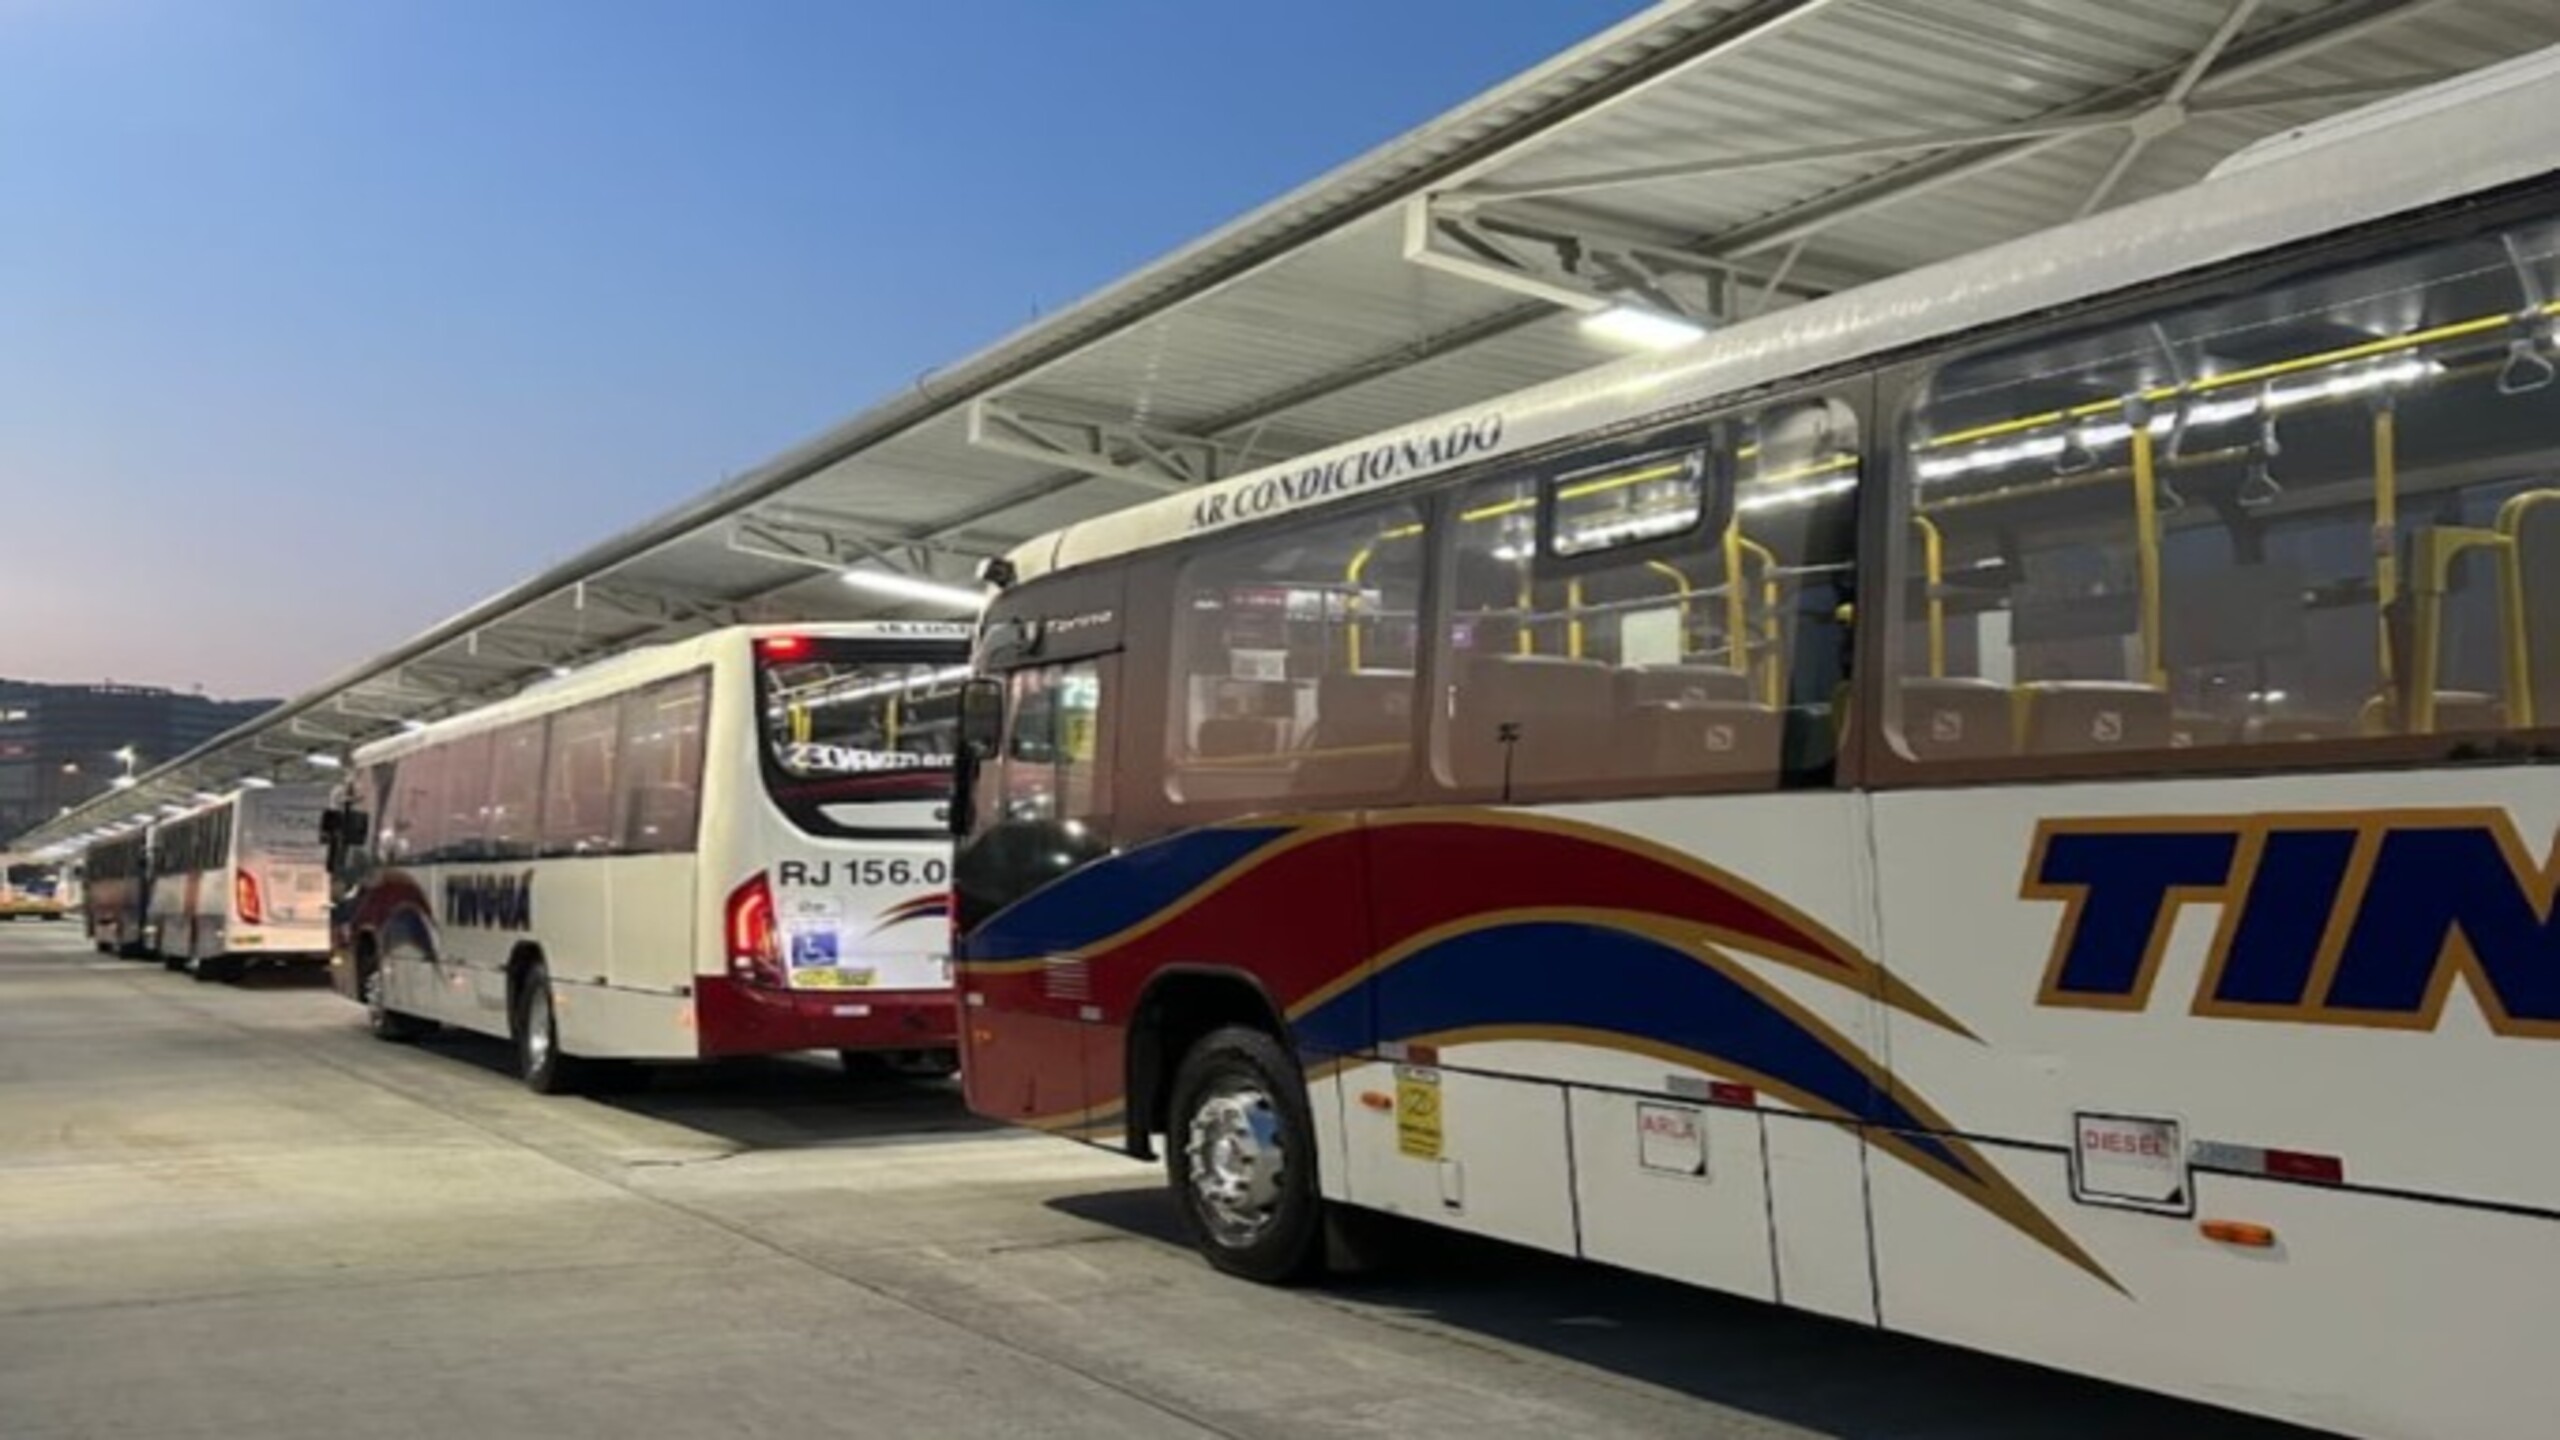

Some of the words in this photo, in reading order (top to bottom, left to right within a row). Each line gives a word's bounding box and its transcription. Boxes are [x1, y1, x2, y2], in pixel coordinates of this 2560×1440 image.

[1189, 491, 1225, 529] AR
[1232, 411, 1503, 519] CONDICIONADO
[779, 860, 831, 887] RJ
[843, 858, 947, 886] 156.0
[1643, 1115, 1698, 1140] ARLA
[2084, 1129, 2172, 1159] DIESEL
